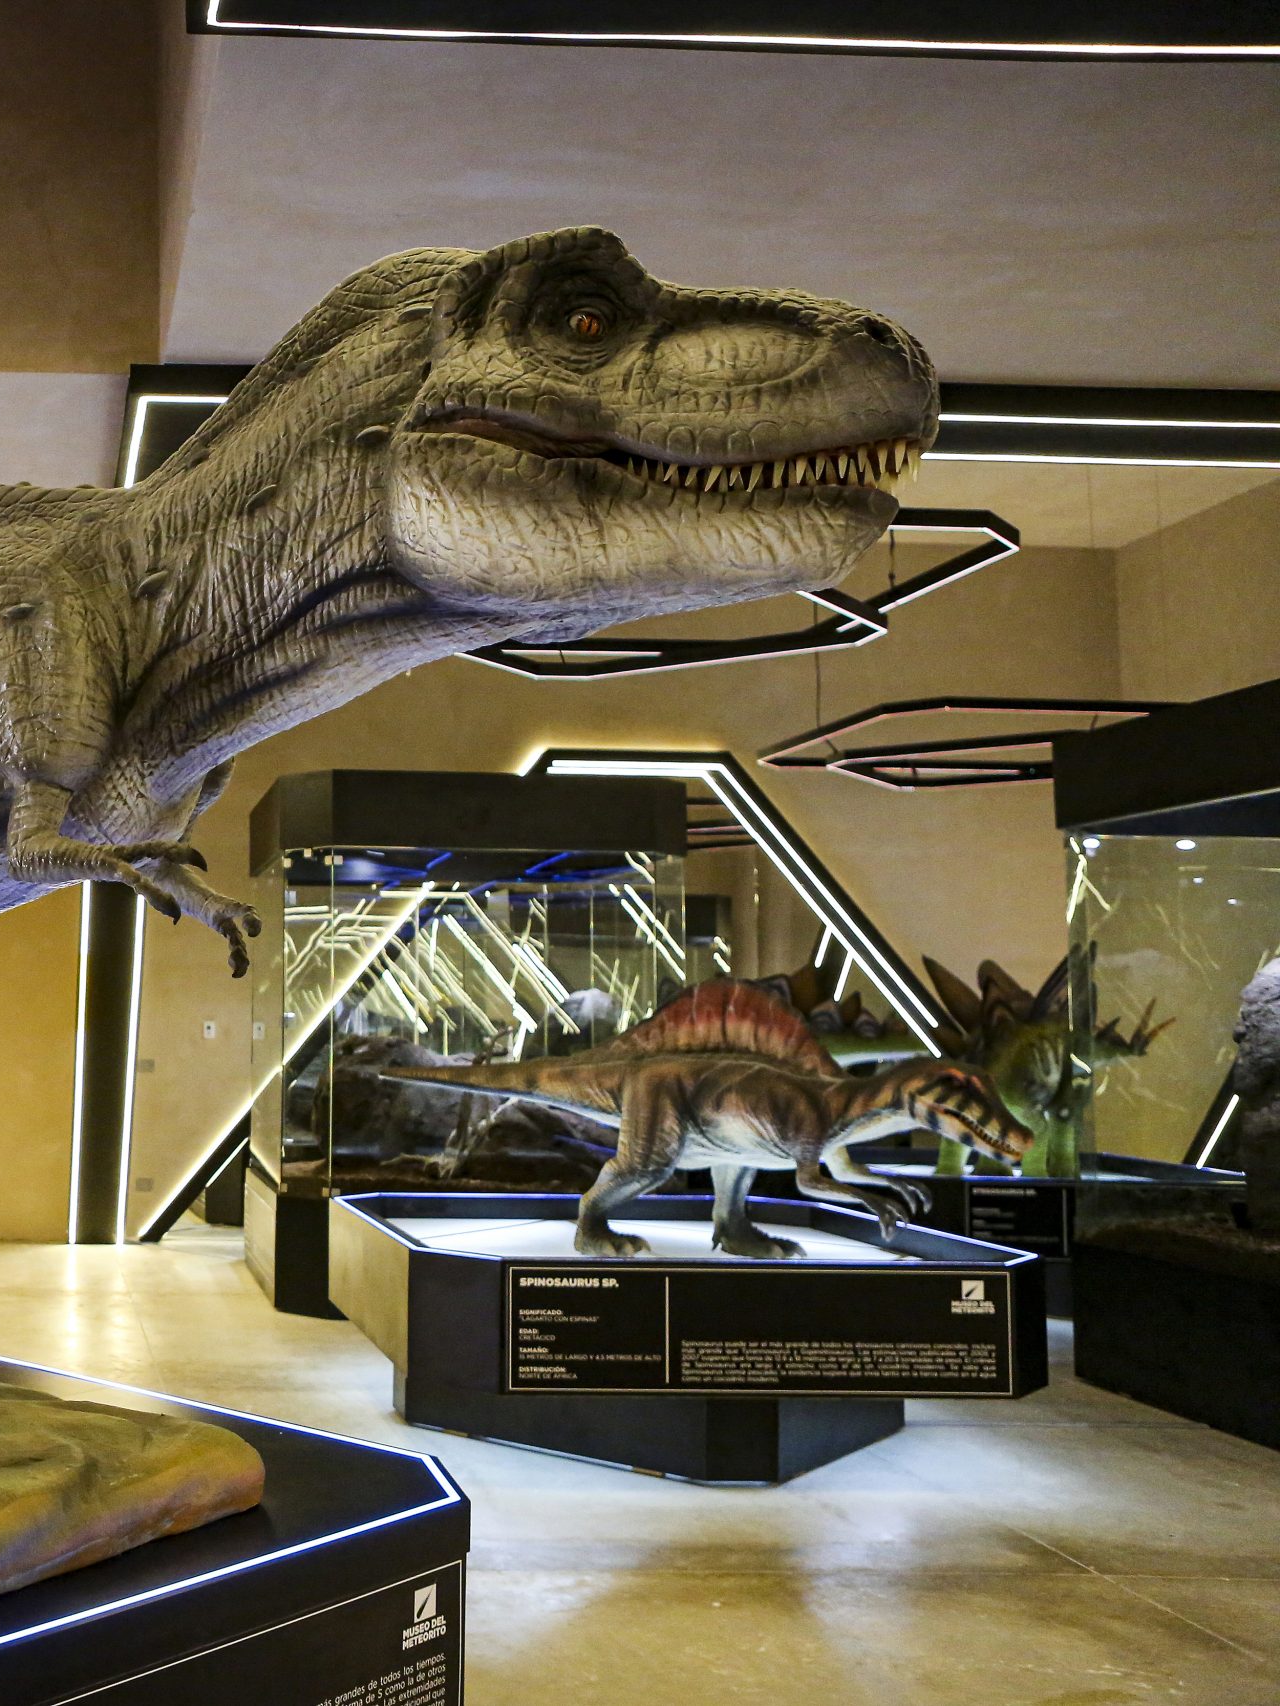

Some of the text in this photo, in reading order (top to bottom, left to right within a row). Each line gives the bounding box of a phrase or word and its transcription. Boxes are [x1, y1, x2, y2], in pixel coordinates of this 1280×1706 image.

[519, 1277, 619, 1288] SPINOSAURUS SP.
[402, 1614, 447, 1640] MUSEO DEL
[402, 1625, 447, 1651] METEORITO
[334, 1686, 366, 1706] grandes
[367, 1679, 378, 1691] de
[380, 1671, 401, 1686] todos
[403, 1666, 414, 1676] los
[365, 1693, 376, 1704] de
[377, 1688, 383, 1699] S
[384, 1680, 406, 1696] como
[407, 1676, 414, 1686] la
[416, 1671, 426, 1682] de
[427, 1664, 446, 1678] otros
[398, 1675, 446, 1702] extremidades
